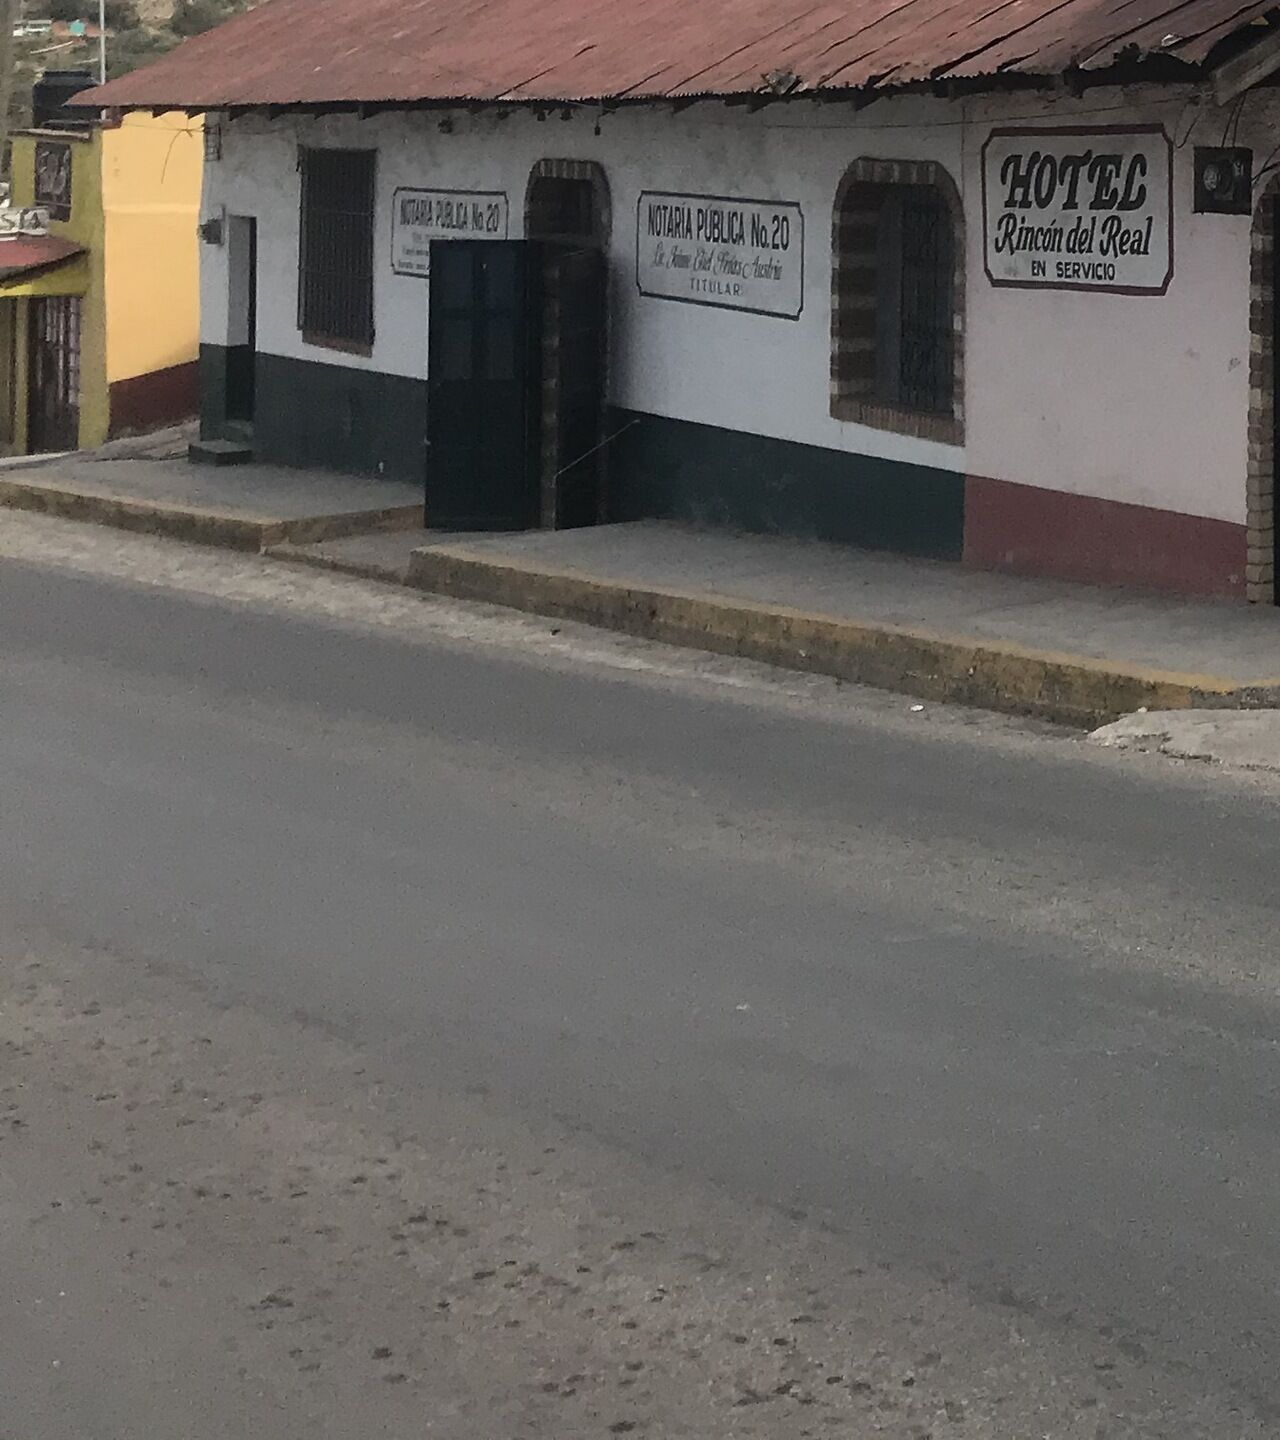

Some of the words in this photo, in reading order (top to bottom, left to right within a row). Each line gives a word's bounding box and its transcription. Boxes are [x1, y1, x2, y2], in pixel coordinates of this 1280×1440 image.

[1000, 149, 1147, 211] HOTEL
[648, 201, 692, 239] NOTARÍA
[697, 203, 745, 246] PÚBLICA
[994, 212, 1064, 256] Rincón
[1066, 215, 1097, 254] del
[1099, 215, 1154, 259] Real
[689, 277, 740, 297] TITULAR
[1031, 261, 1046, 277] EN
[1056, 261, 1116, 281] SERVICIO
